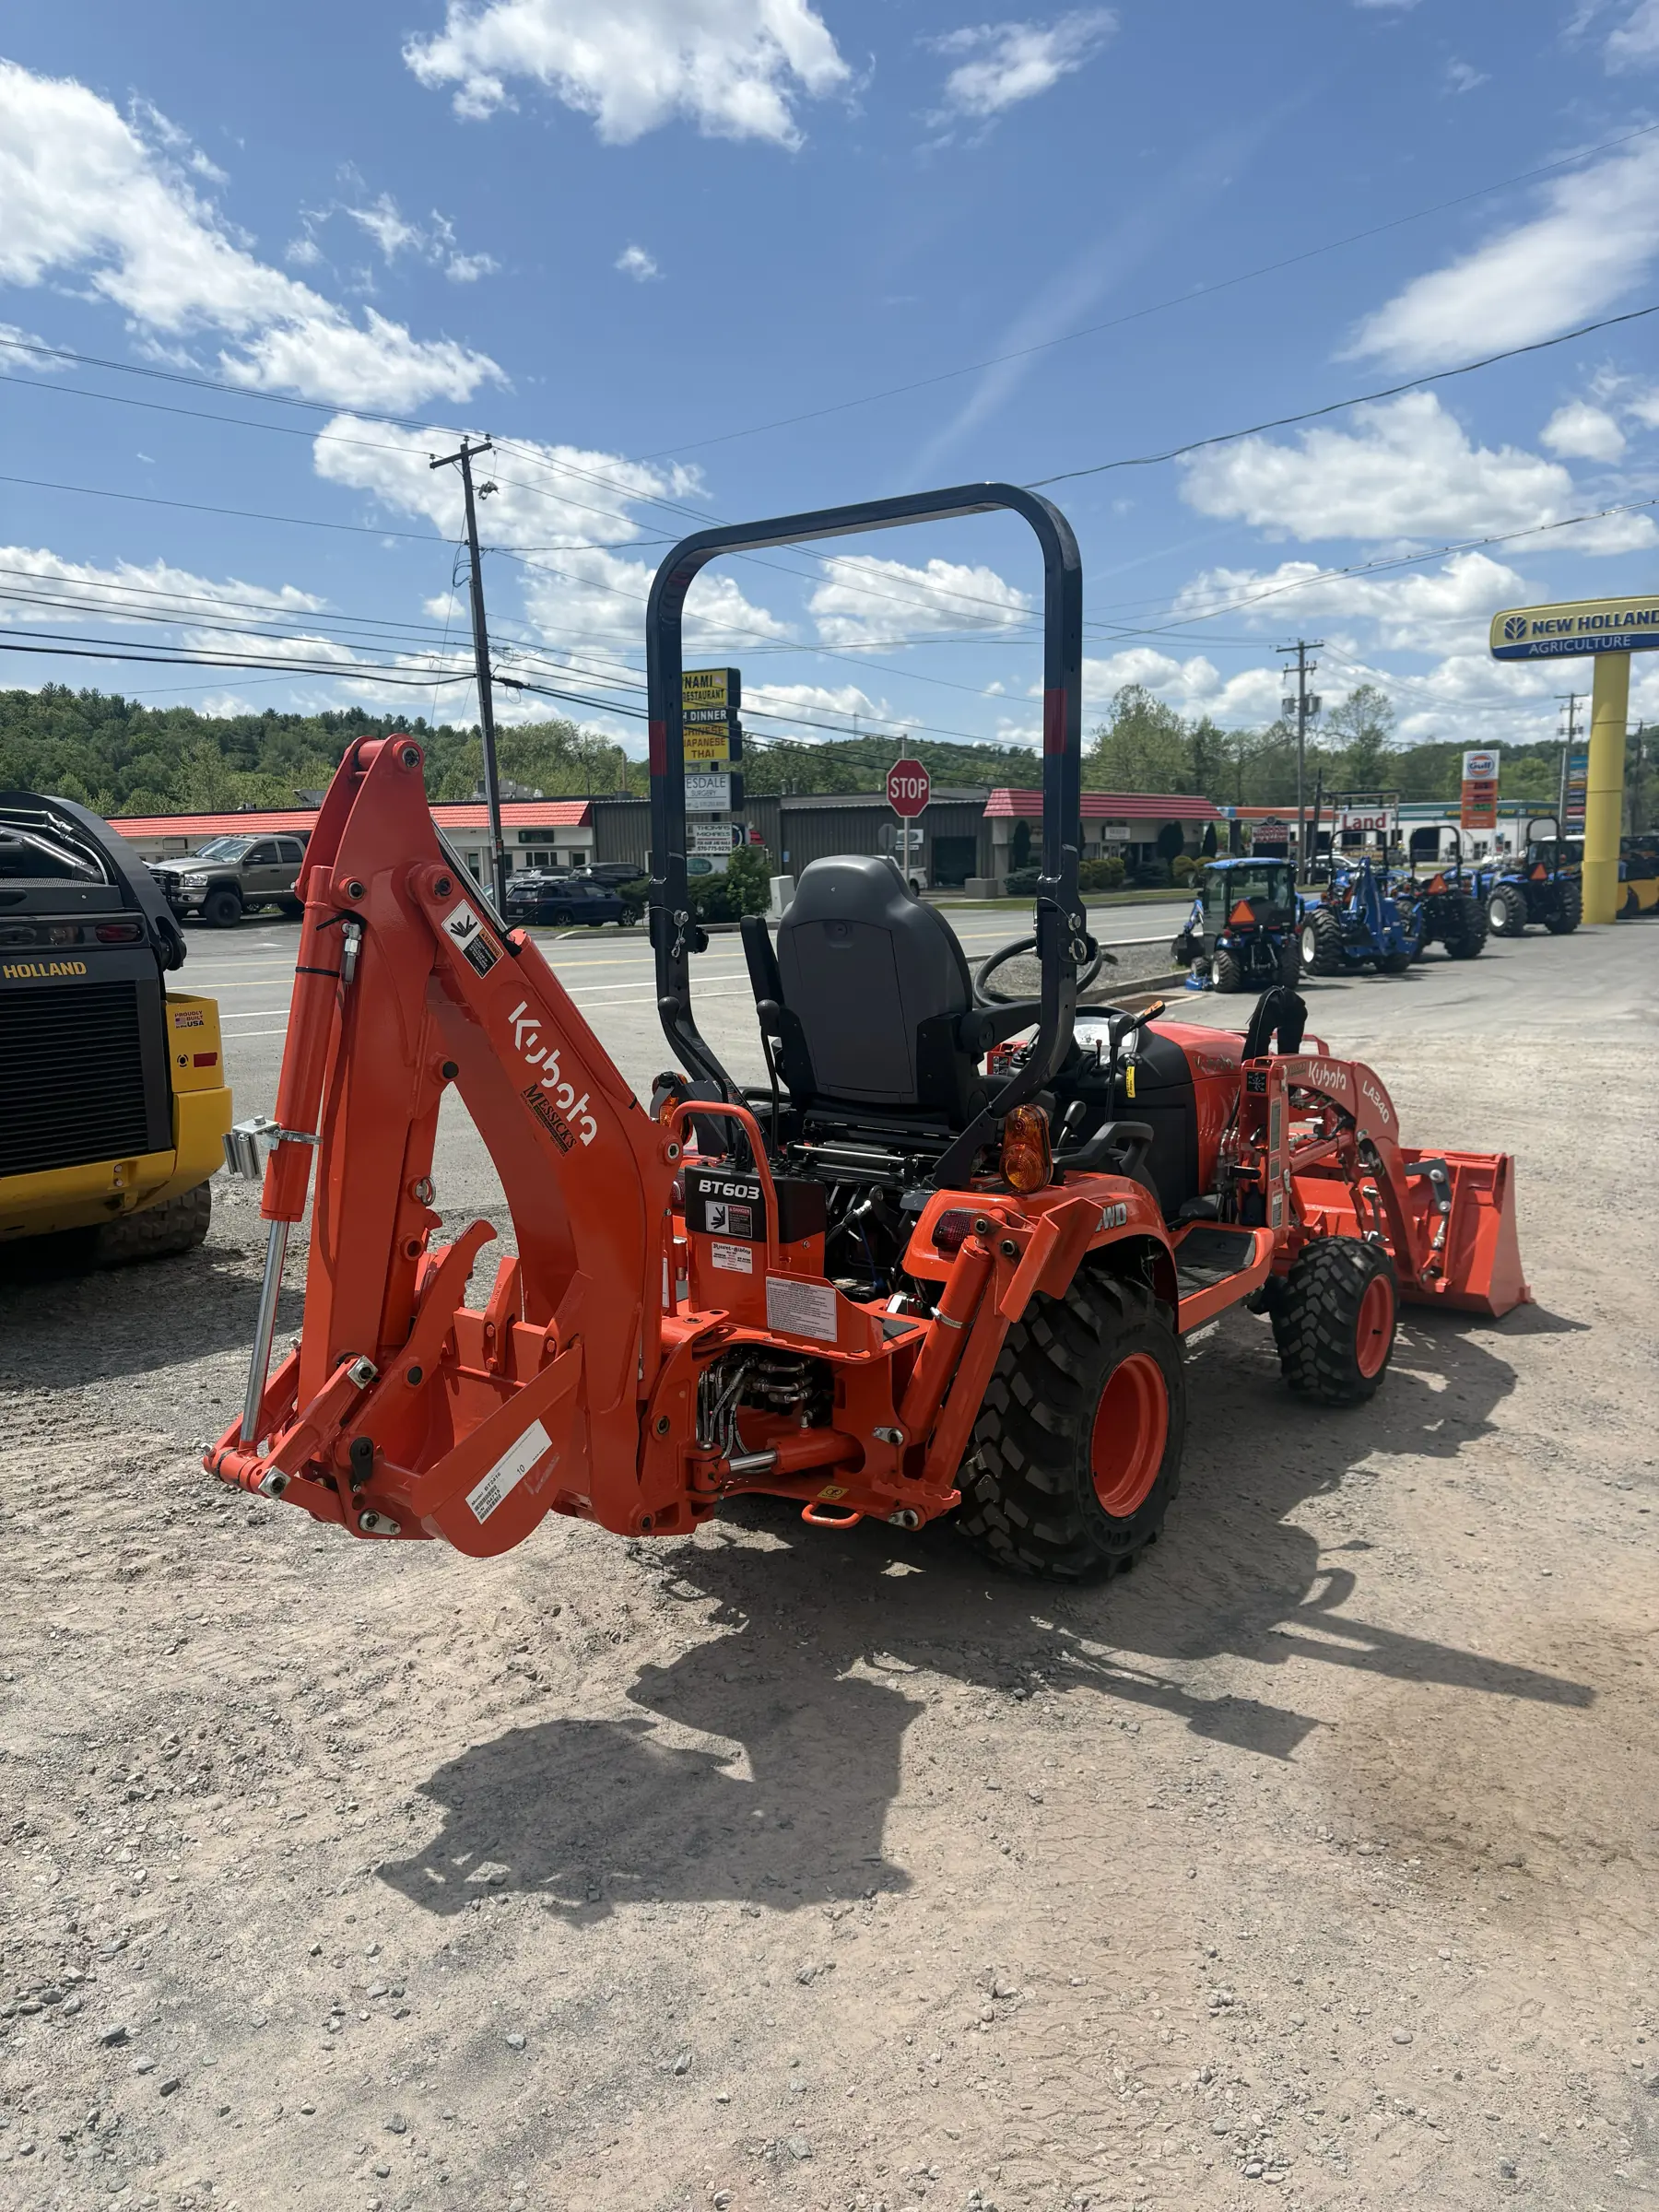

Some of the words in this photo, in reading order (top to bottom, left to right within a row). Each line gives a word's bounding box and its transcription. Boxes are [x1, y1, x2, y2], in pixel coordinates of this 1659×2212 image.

[1532, 618, 1574, 635] NEW
[1578, 609, 1659, 631] HOLLAND
[1529, 635, 1631, 654] AGRICULTURE
[683, 675, 712, 688] NAMI
[690, 710, 727, 721] DINNER
[691, 749, 714, 759] THAI
[1469, 761, 1491, 770] Gulf
[686, 777, 726, 788] ESDALE
[890, 777, 927, 799] STOP
[1343, 812, 1386, 830] Land
[2, 961, 87, 979] HOLLAND
[508, 1000, 597, 1147] Kubota
[1309, 1061, 1347, 1090] Kubota
[1362, 1080, 1390, 1124] LA340
[523, 1082, 577, 1148] MESSICK'S
[699, 1180, 760, 1200] BT603
[516, 1464, 525, 1476] 10
